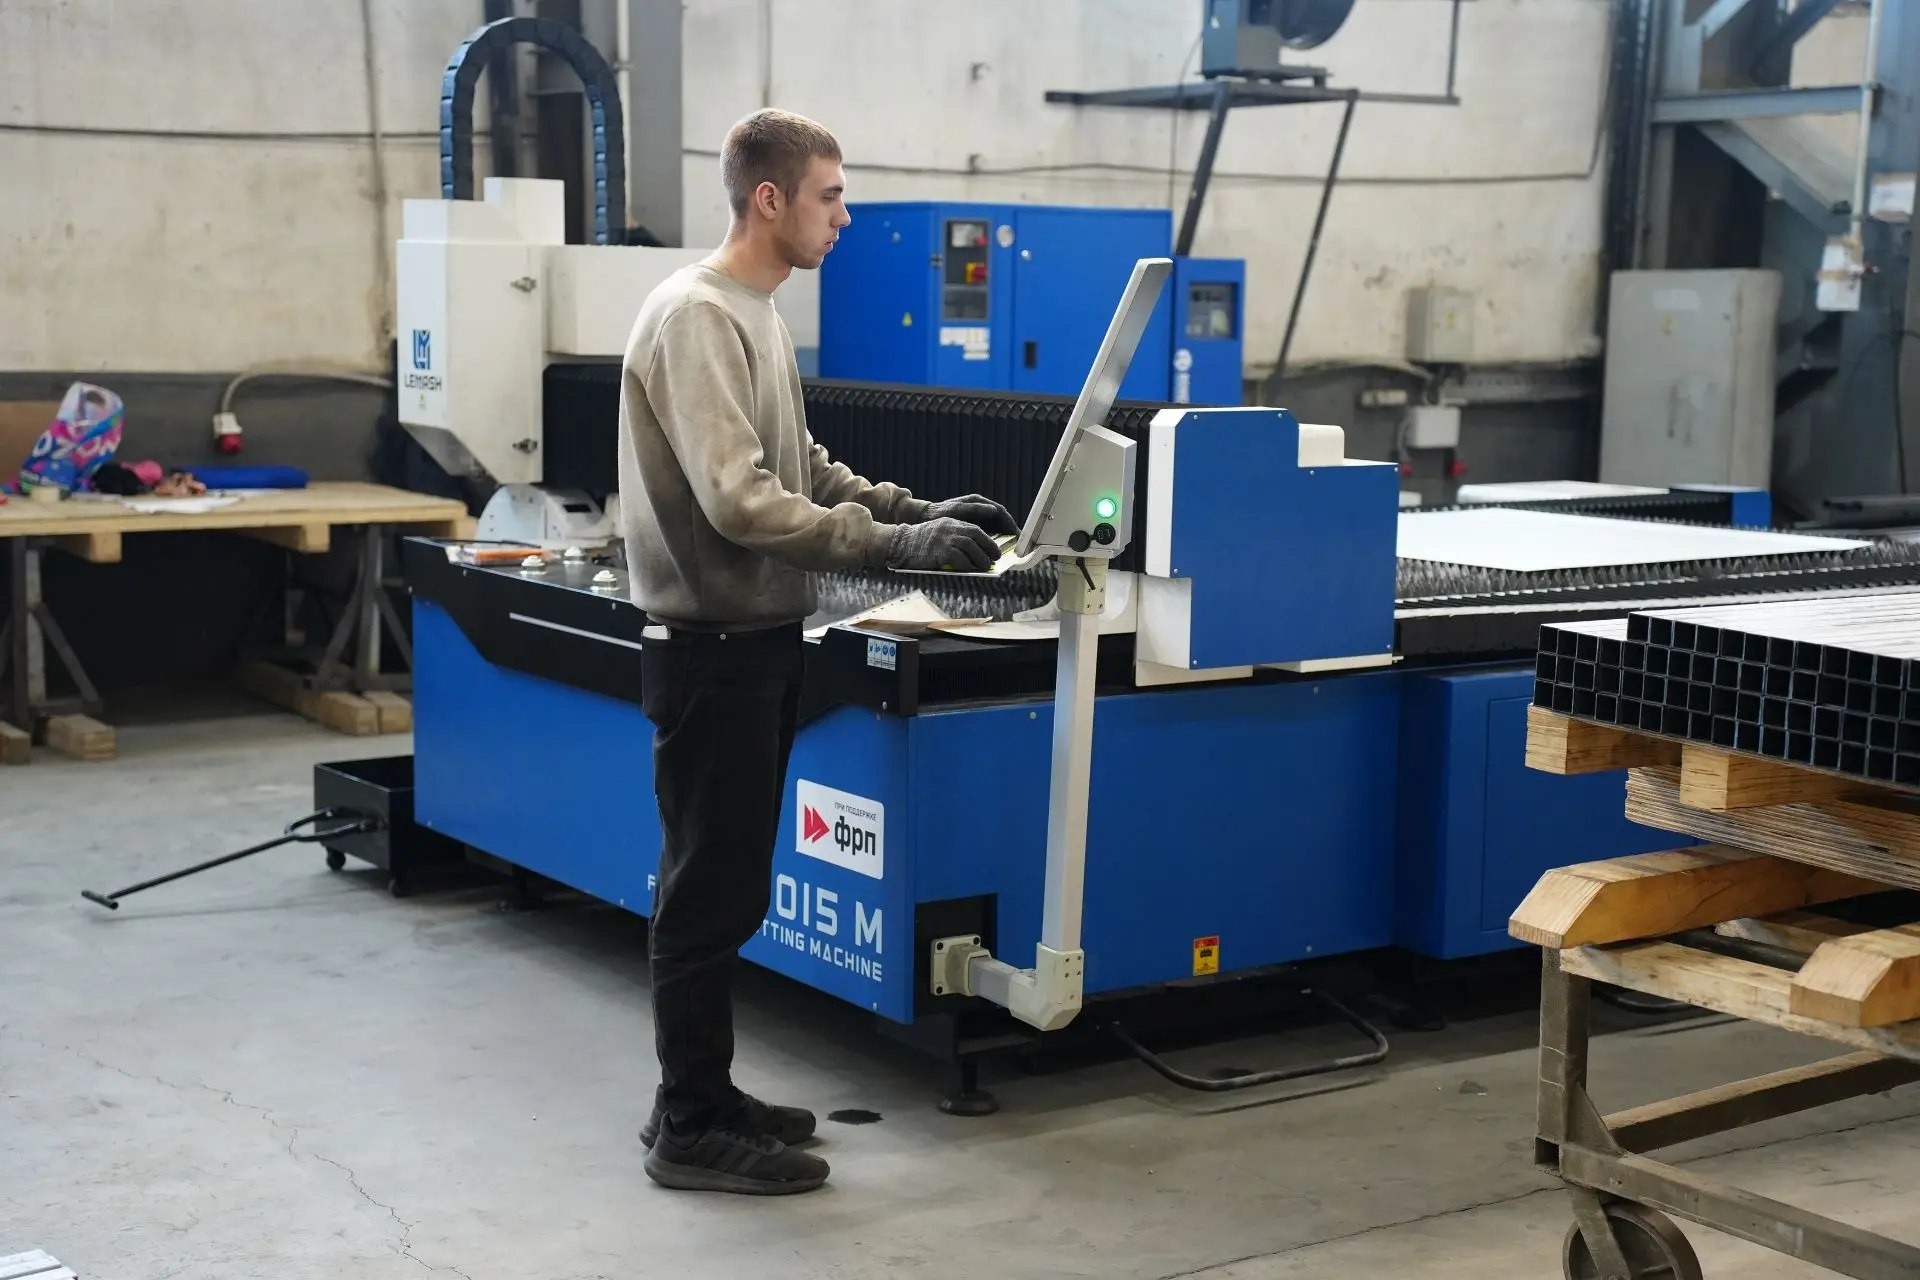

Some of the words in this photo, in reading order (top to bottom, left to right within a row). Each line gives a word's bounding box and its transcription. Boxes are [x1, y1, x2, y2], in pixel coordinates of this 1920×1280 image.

[32, 430, 122, 459] OZON
[756, 919, 805, 952] TTING
[809, 936, 882, 983] MACHINE
[854, 900, 883, 955] M
